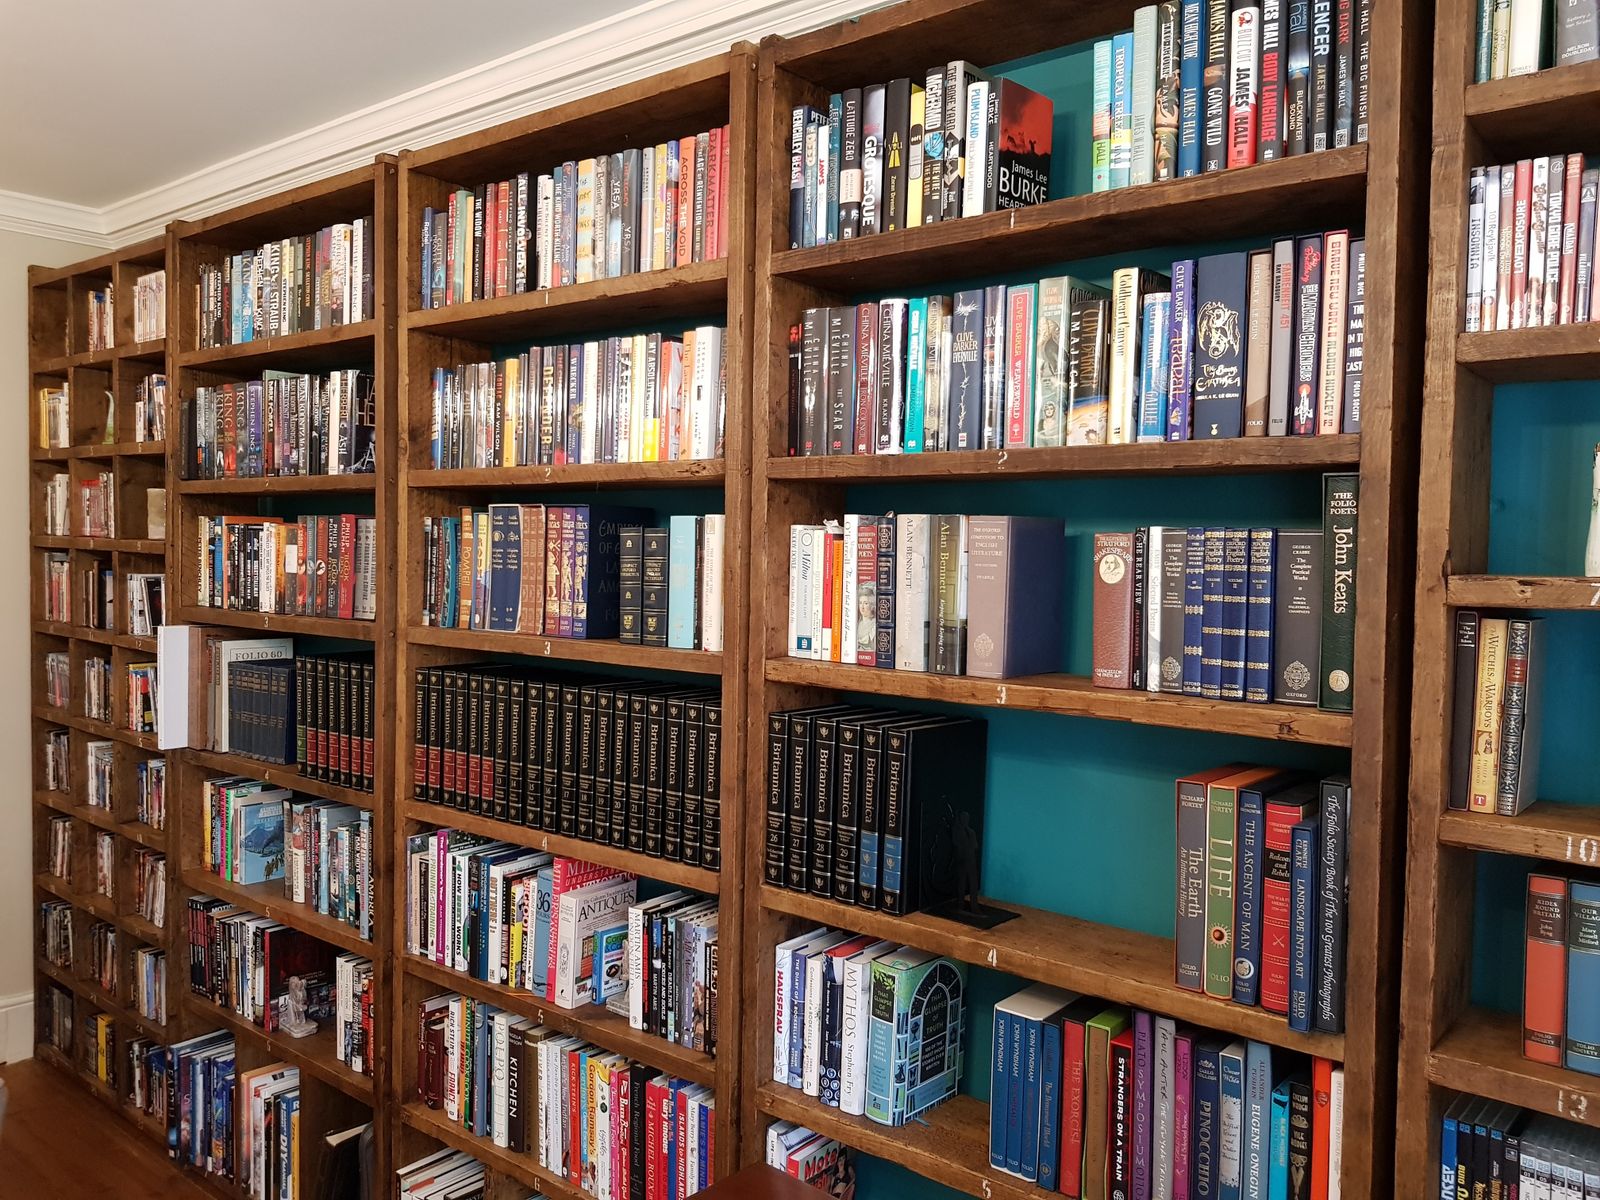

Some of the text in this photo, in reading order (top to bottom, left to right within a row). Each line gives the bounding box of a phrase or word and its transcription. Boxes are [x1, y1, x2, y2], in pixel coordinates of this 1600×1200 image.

[1263, 24, 1279, 50] HALL
[1338, 14, 1349, 44] DARK
[1359, 10, 1368, 119] HALL THE BIG FINISH
[1183, 88, 1196, 146] JAMES HALL
[1207, 87, 1222, 146] GONE WILD
[1234, 67, 1250, 148] JAMES HALL
[845, 101, 855, 161] LATITUDE ZERO
[680, 156, 689, 205] ACROSS
[862, 136, 877, 226] GROTESQUE
[1000, 167, 1047, 205] BURKE
[1012, 160, 1048, 184] James Lee
[611, 180, 621, 210] YRSA
[680, 204, 688, 228] THE
[553, 238, 561, 263] KILLING
[1469, 219, 1480, 269] INSOMNIA
[269, 244, 280, 330] KING STRAUB
[1174, 265, 1185, 289] CLIVE
[1329, 278, 1340, 301] NEW
[1173, 290, 1184, 323] BARKER
[1280, 263, 1292, 330] FAHRENHEIT 451
[882, 308, 891, 341] CHINA
[956, 332, 974, 342] CLIVE
[1327, 302, 1339, 338] WORLD
[841, 333, 850, 368] CHINA
[953, 341, 978, 351] BARKER
[1070, 311, 1081, 389] IMAJICA
[216, 393, 224, 429] KING
[224, 392, 233, 429] KING
[237, 390, 245, 428] KING
[1323, 379, 1335, 417] HUXLEY
[1352, 381, 1361, 422] FOLIO SOCIETY
[339, 434, 348, 455] ASH
[1330, 500, 1357, 508] FOLIO
[462, 545, 473, 587] POMPEII
[801, 550, 812, 581] Milton
[904, 546, 913, 589] BENNETT
[938, 521, 949, 594] Alan Bennett
[1135, 557, 1143, 580] REAR
[1333, 525, 1353, 614] John Keats
[235, 650, 283, 661] FOLIO 60
[529, 706, 538, 759] Britannica
[599, 717, 608, 772] Britannica
[632, 721, 642, 778] Britannica
[668, 726, 679, 785] Britannica
[707, 732, 717, 792] Britannica
[793, 746, 804, 809] Britannica
[841, 753, 853, 819] Britannica
[888, 760, 900, 828] Britannica
[1328, 795, 1337, 812] The
[770, 833, 778, 842] 26
[792, 838, 800, 847] 27
[1326, 813, 1338, 834] Folio
[816, 842, 825, 852] 28
[1295, 838, 1303, 868] CLARK
[1323, 835, 1337, 867] Society
[1188, 847, 1205, 919] The Earth
[1210, 837, 1233, 899] LIFE
[1240, 820, 1256, 951] THE ASCENT OF MAN
[1325, 867, 1337, 889] Book
[577, 889, 635, 923] ANTIQUES
[1322, 889, 1336, 902] of
[1324, 902, 1336, 919] The
[1581, 907, 1597, 915] OUR
[1295, 878, 1306, 979] LANDSCAPE INTO ART
[633, 955, 641, 980] AMIS
[987, 948, 998, 967] 4
[1322, 934, 1334, 967] Greatest
[775, 970, 785, 1035] HAUSFRAU
[1297, 990, 1306, 1019] FOLIO
[1318, 968, 1334, 1020] Photographs
[536, 1009, 544, 1024] 5
[843, 966, 858, 1096] MYTHOS Stephen Fry
[926, 1022, 944, 1034] TRUTH
[996, 1020, 1005, 1073] JOHN WYNDHAM
[509, 1056, 518, 1118] KITCHEN
[588, 1064, 597, 1155] Gordon Ramsay's
[1115, 1056, 1125, 1181] STRANGERS ON A TRAIN
[647, 1121, 655, 1160] MICHEL
[1198, 1099, 1212, 1196] PINOCCHIO
[1249, 1103, 1261, 1199] EUGENE ONEGIN
